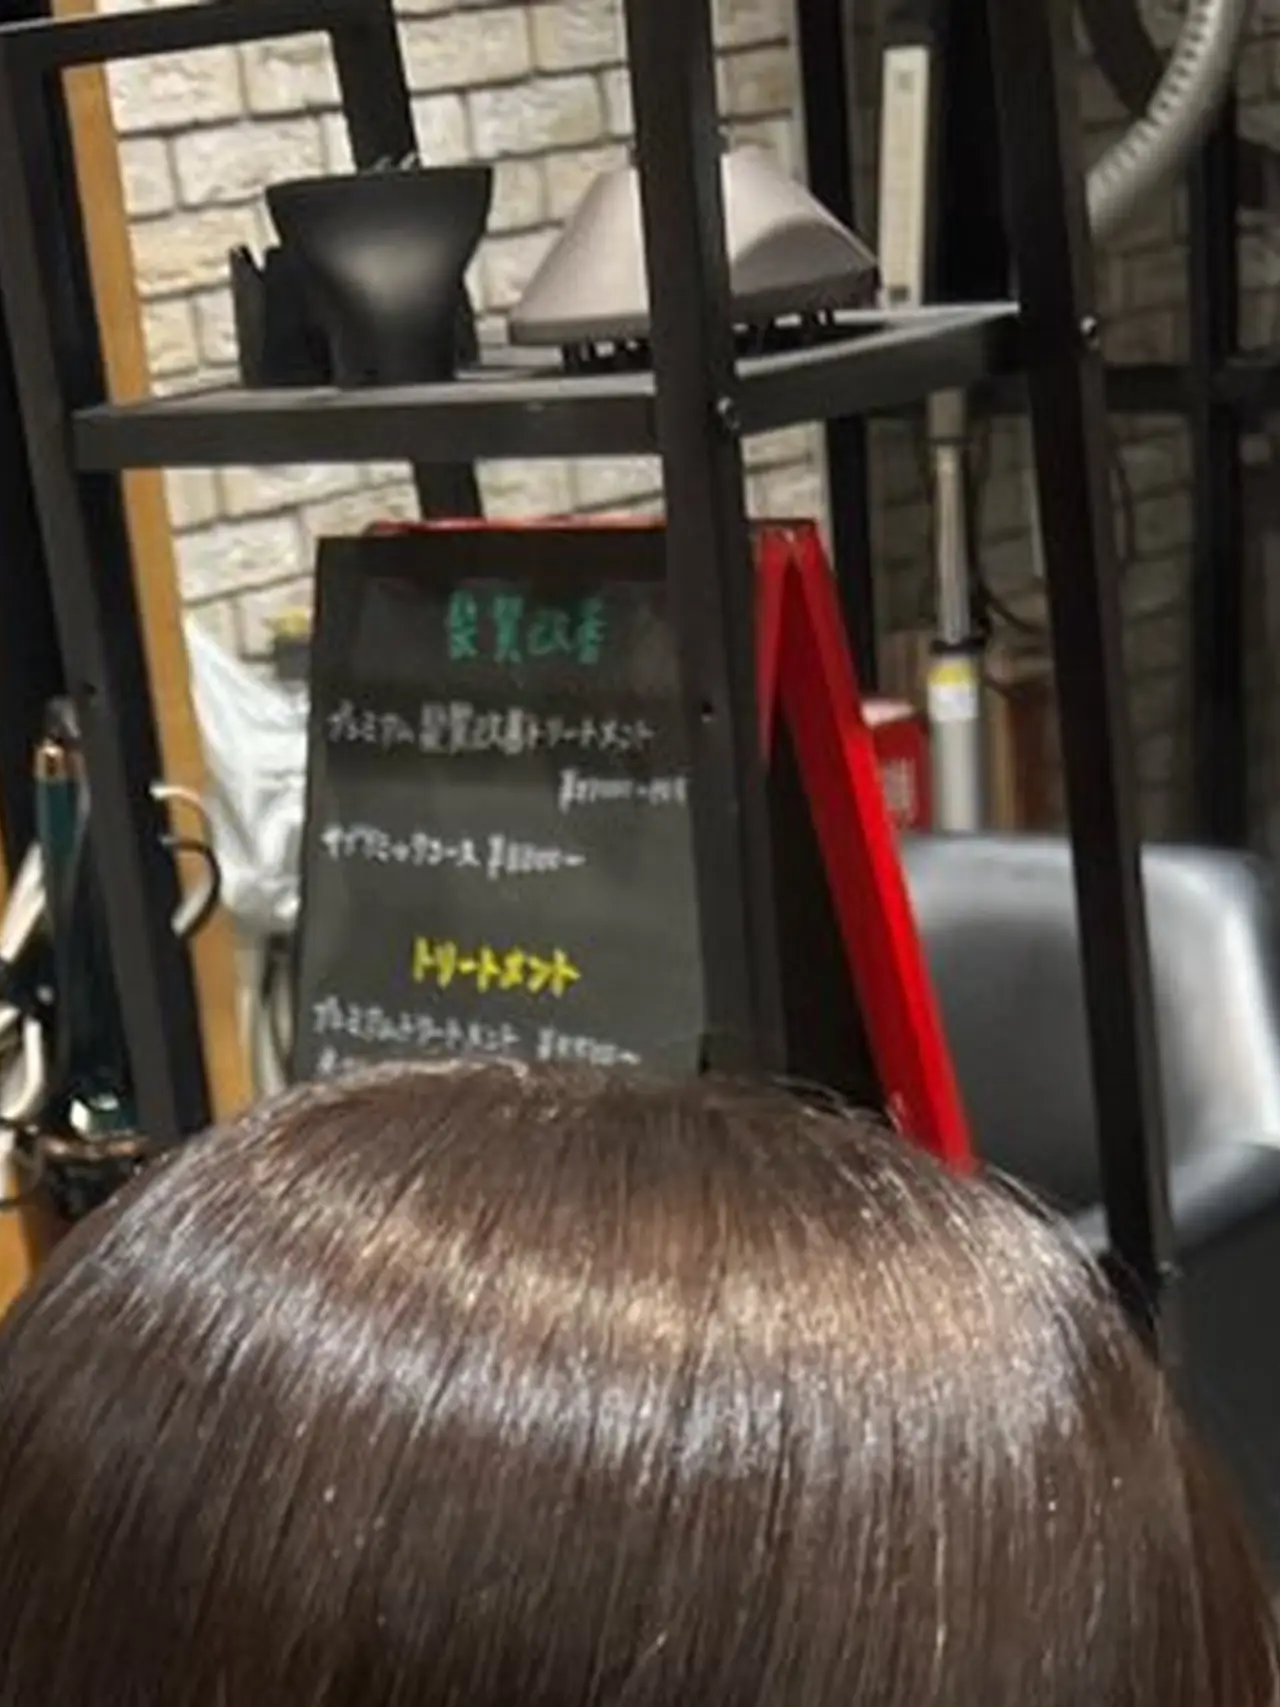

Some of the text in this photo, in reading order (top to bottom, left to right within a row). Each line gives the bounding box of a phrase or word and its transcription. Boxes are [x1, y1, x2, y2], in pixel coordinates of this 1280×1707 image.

[413, 934, 581, 998] トリートメント
